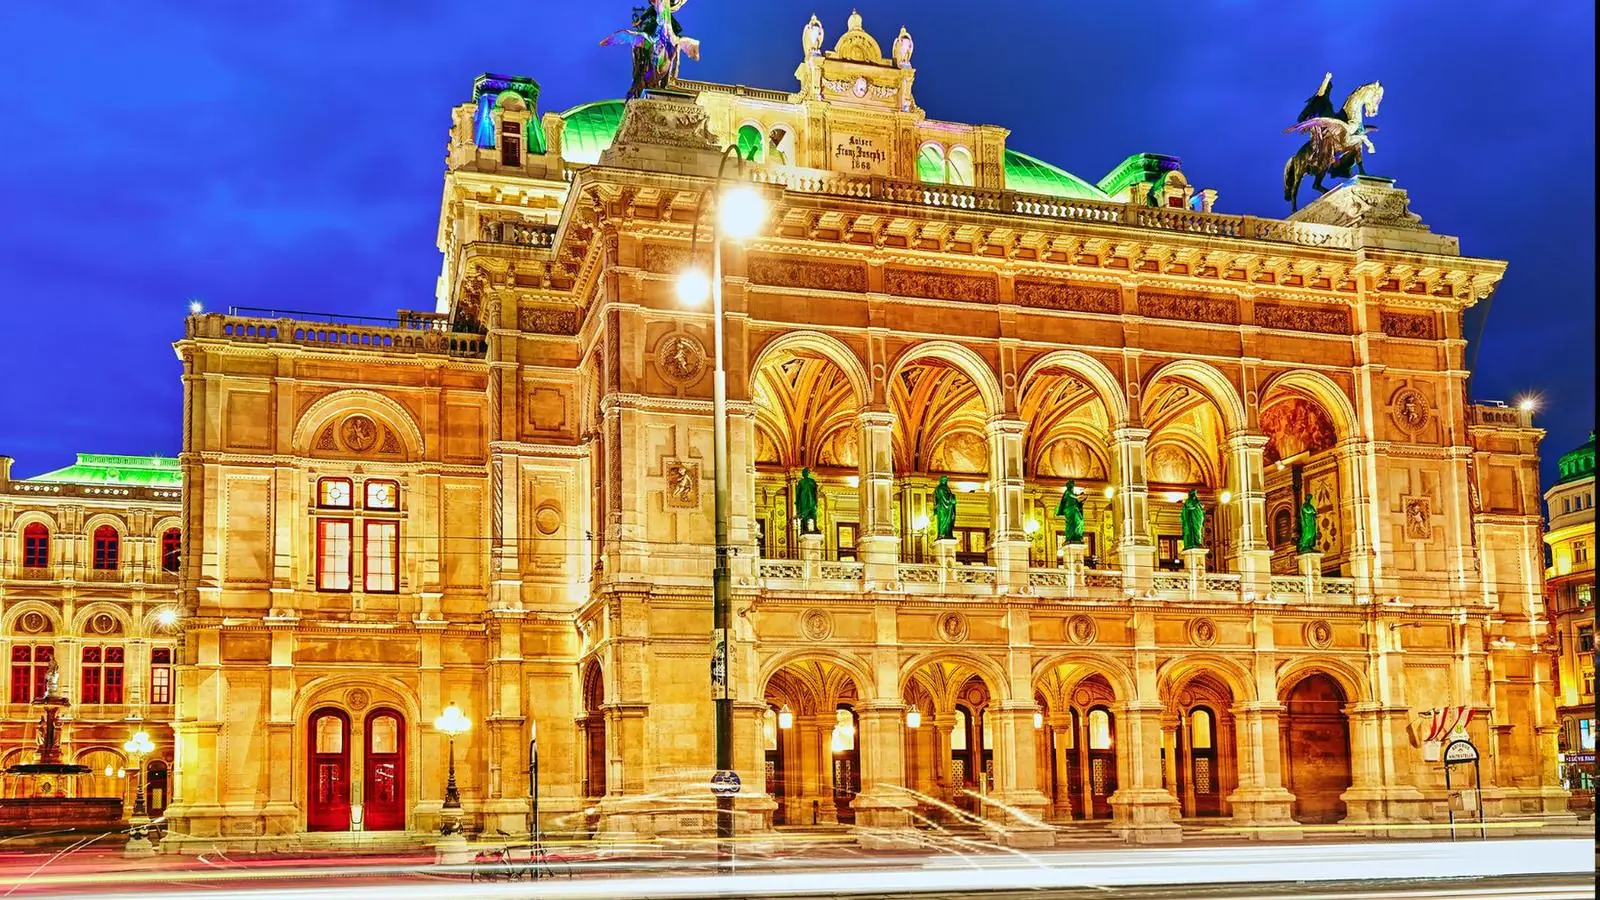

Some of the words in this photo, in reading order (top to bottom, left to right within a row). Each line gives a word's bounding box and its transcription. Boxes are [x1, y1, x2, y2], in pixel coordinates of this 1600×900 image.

[849, 136, 873, 146] Kaiser
[835, 144, 856, 160] Franz
[856, 146, 881, 163] Joseph
[852, 160, 871, 170] 1868
